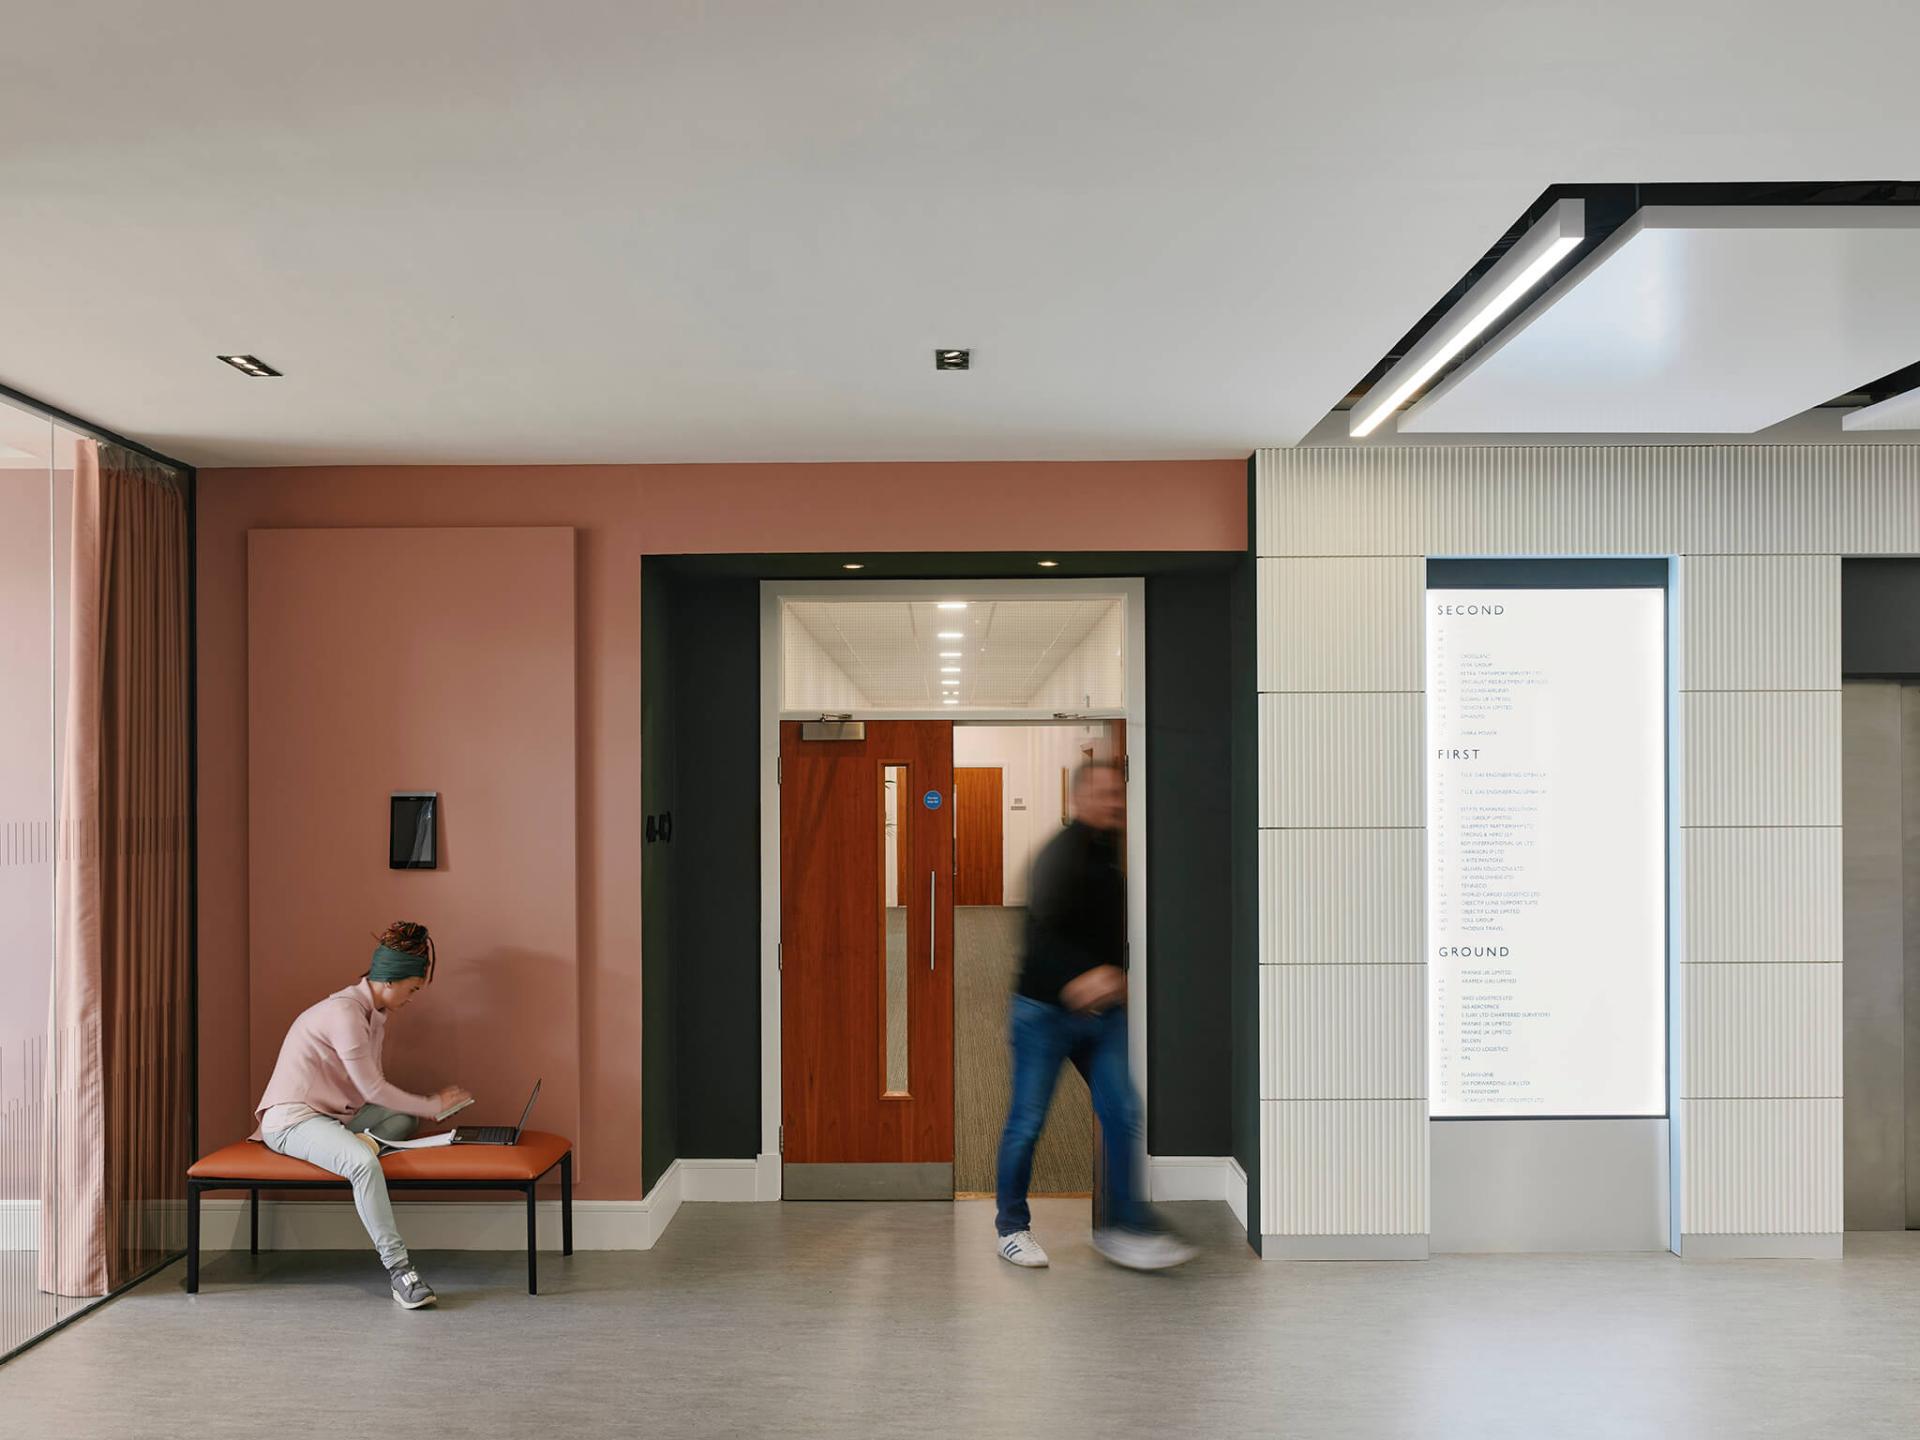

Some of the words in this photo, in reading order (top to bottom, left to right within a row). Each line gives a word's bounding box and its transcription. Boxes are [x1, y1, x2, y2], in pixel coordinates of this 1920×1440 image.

[1436, 604, 1505, 617] SECOND
[1437, 749, 1480, 760] FIRST
[1438, 946, 1510, 957] GROUND
